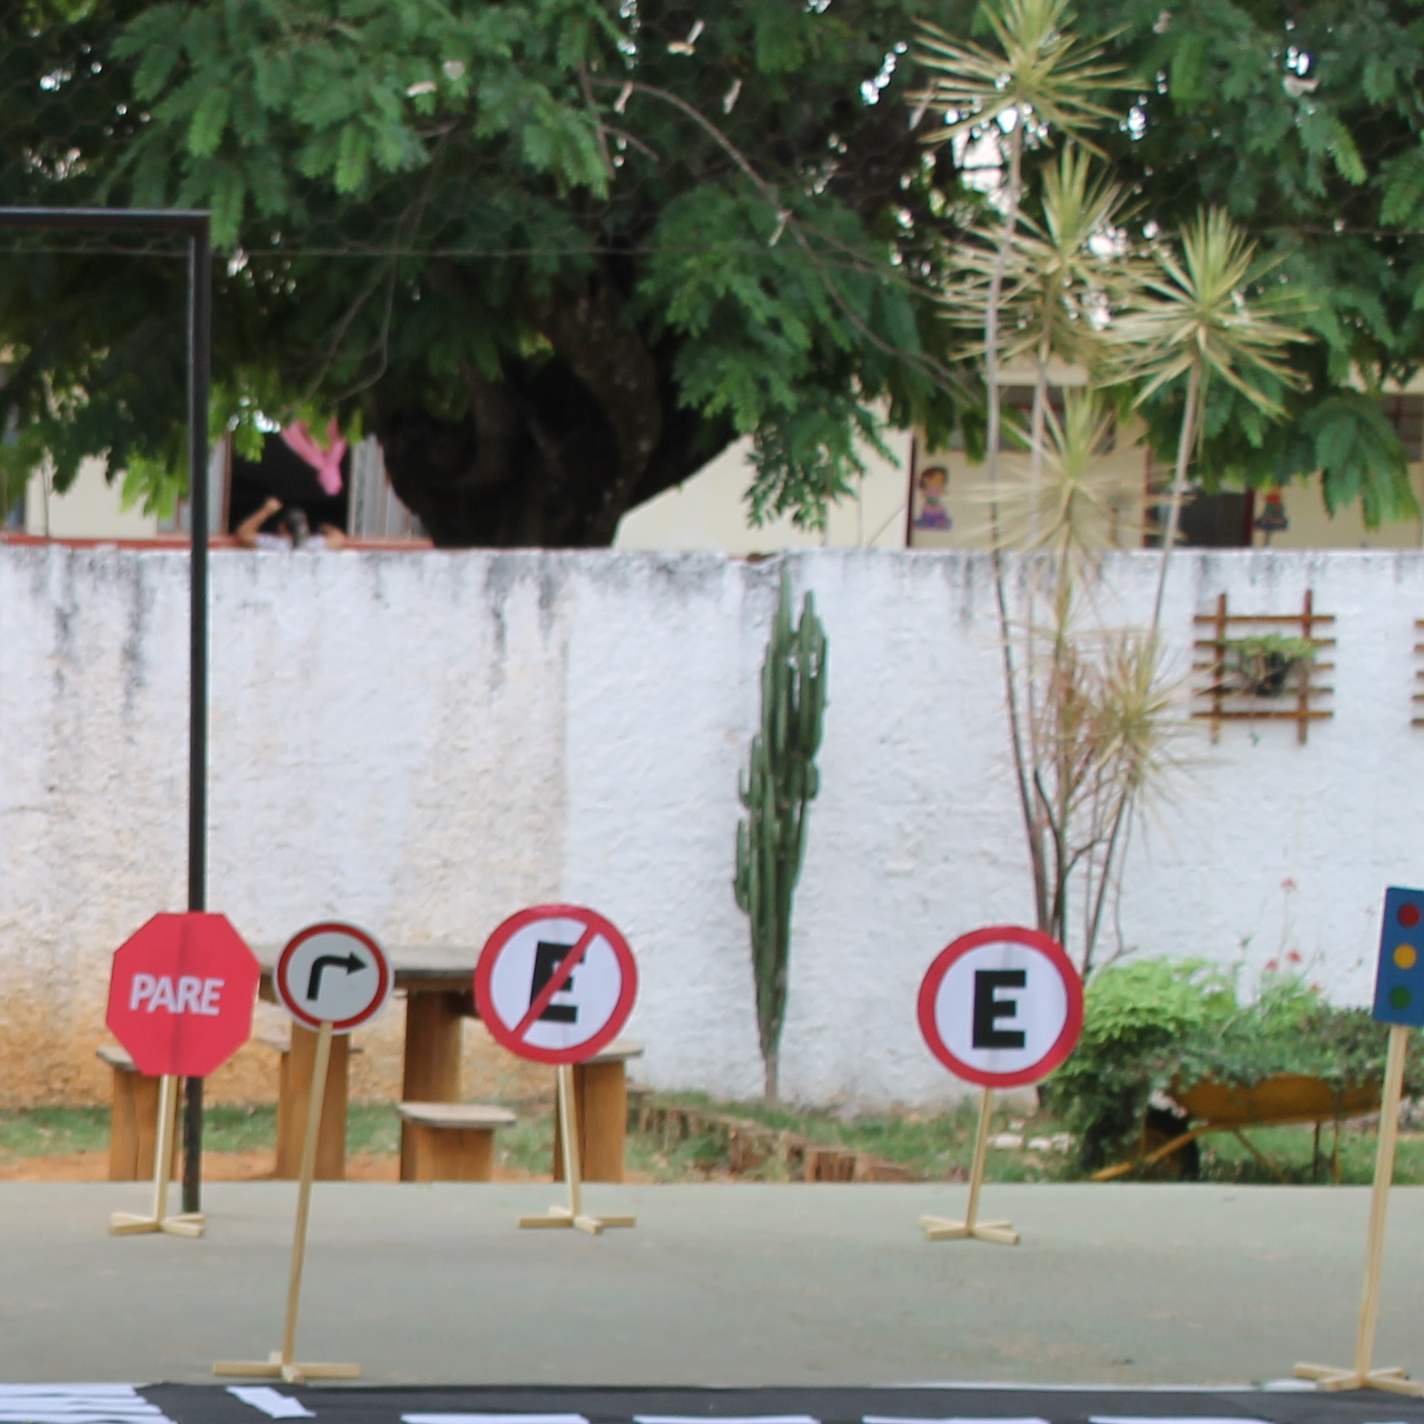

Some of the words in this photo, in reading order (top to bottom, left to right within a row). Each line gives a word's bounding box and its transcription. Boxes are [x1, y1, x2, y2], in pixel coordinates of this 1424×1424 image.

[129, 972, 226, 1017] PARE
[530, 940, 586, 1024] E
[972, 969, 1027, 1049] E
